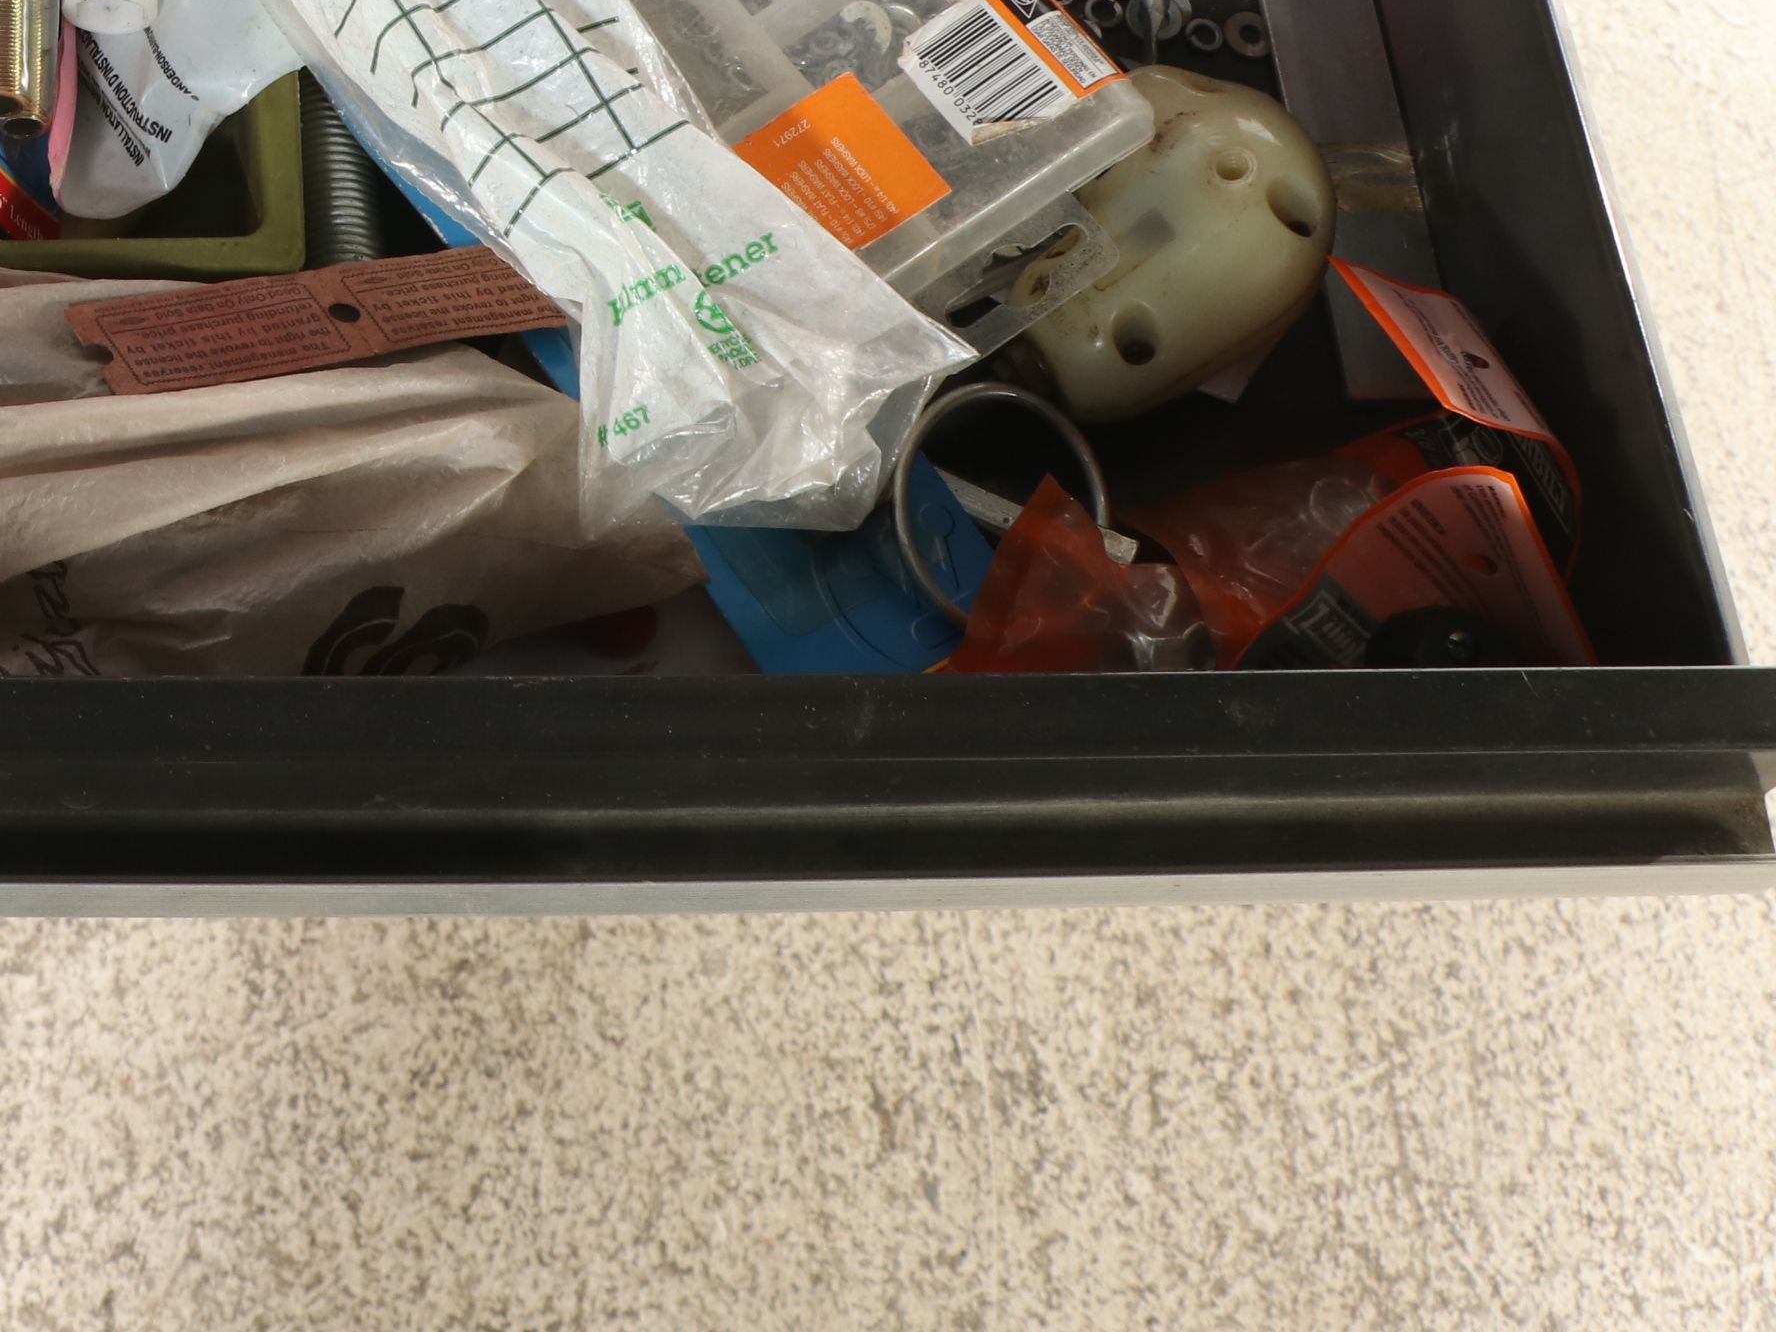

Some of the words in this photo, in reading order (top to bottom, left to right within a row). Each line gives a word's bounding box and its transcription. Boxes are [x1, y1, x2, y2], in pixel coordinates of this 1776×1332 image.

[917, 59, 955, 98] 87480
[113, 83, 172, 143] INSTRUCTION
[772, 118, 812, 149] 272971
[830, 136, 858, 167] WASHERS
[854, 164, 872, 183] LOCK
[453, 262, 470, 272] On
[420, 274, 477, 291] purchase
[382, 284, 418, 298] price.
[443, 291, 471, 302] this
[475, 286, 490, 296] by
[216, 299, 234, 309] On
[237, 292, 265, 305] Only
[395, 296, 438, 309] ticket
[495, 298, 507, 307] to
[511, 293, 538, 305] right
[186, 303, 213, 315] Date
[245, 301, 314, 321] refunding
[373, 302, 391, 312] by
[430, 307, 449, 316] the
[452, 300, 492, 313] revoke
[155, 308, 183, 321] Sold
[382, 310, 427, 323] license
[452, 308, 532, 326] management
[178, 314, 243, 333] purchase
[261, 312, 321, 332] granted
[136, 326, 176, 340] price.
[201, 331, 232, 344] this
[236, 325, 256, 337] by
[274, 329, 305, 345] right
[308, 326, 330, 338] the
[126, 344, 144, 355] by
[150, 337, 197, 352] ticket
[209, 340, 256, 356] revoke
[257, 338, 272, 348] to
[303, 341, 329, 353] The
[134, 353, 182, 368] license
[184, 349, 207, 361] the
[208, 346, 297, 370] management
[143, 362, 204, 379] reserves
[612, 404, 651, 437] 467
